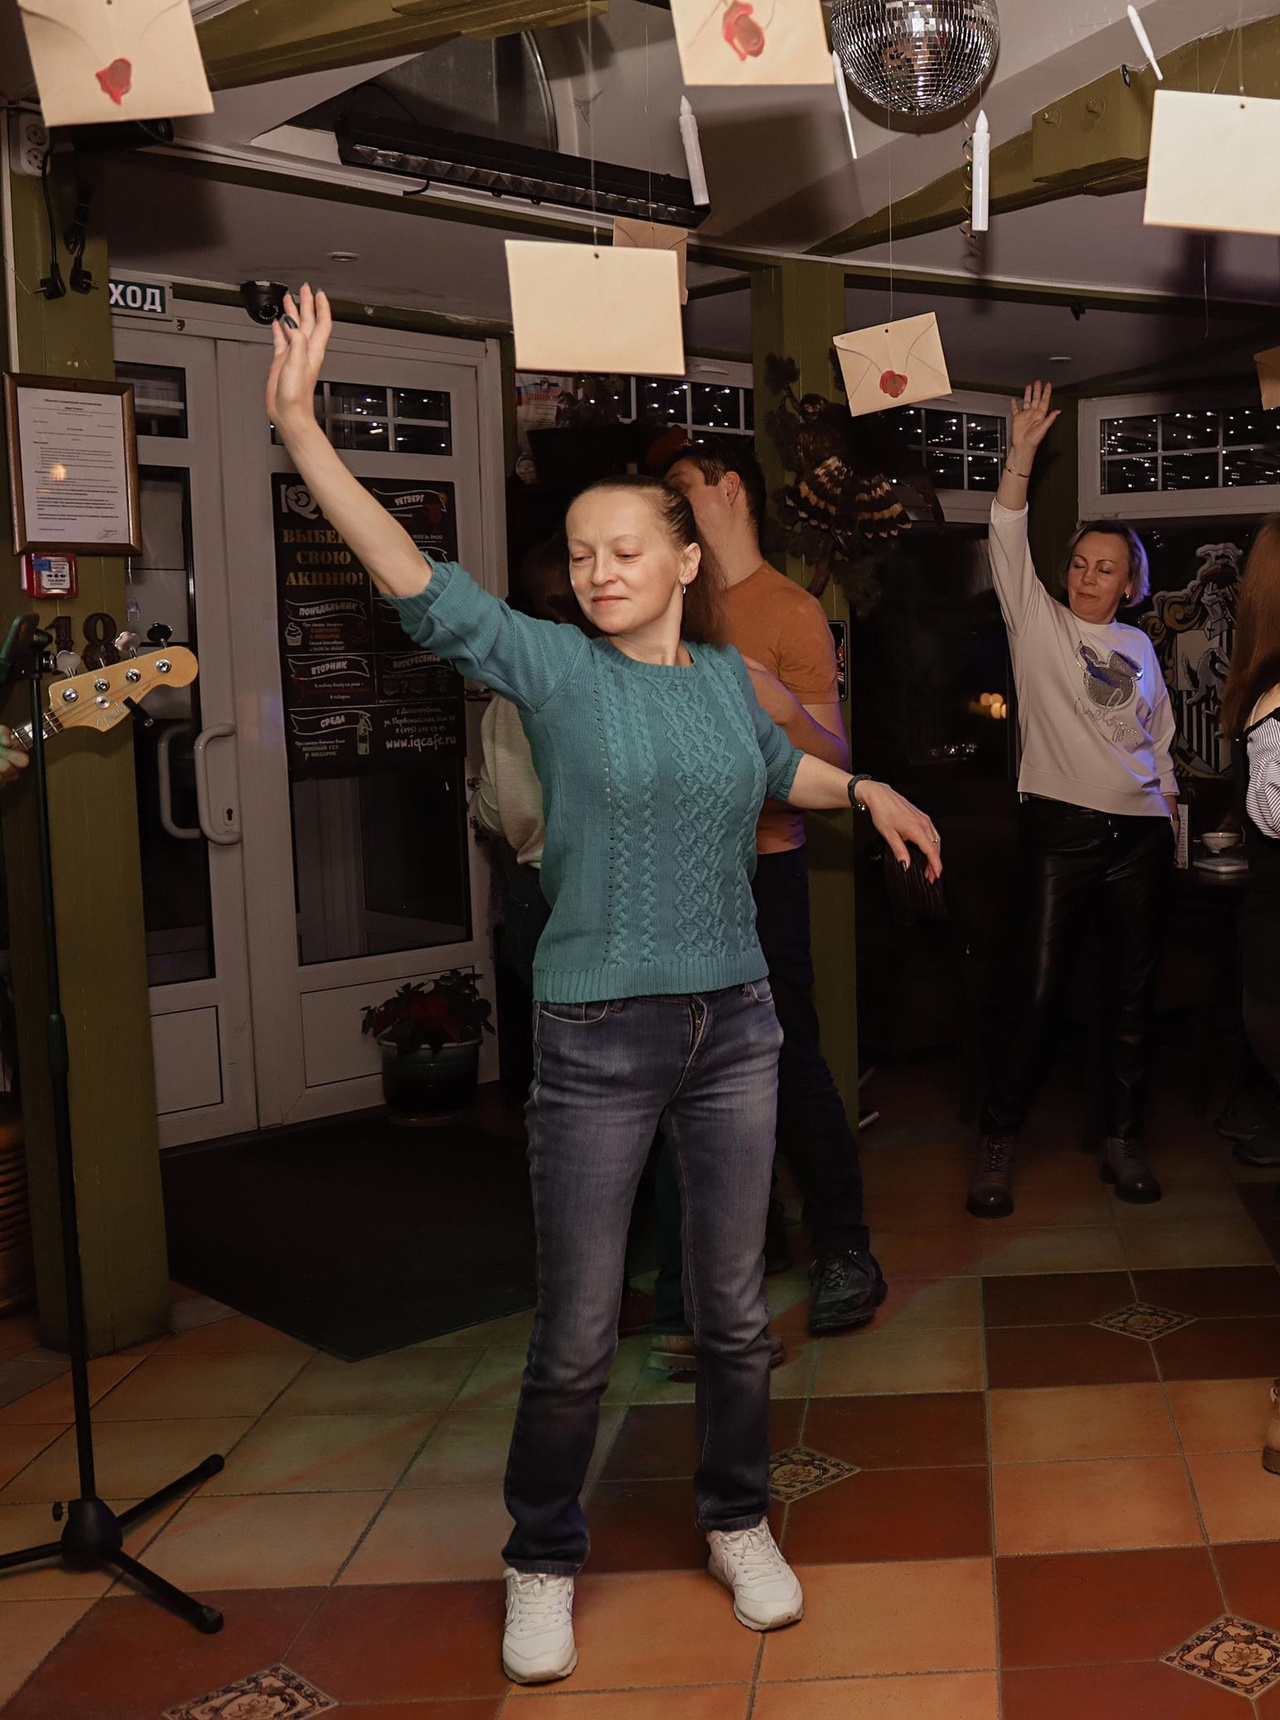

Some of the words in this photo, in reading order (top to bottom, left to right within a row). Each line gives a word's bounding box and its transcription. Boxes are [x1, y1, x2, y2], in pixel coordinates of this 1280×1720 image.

[296, 550, 352, 565] СВОЮ
[285, 571, 364, 586] АКЦИЮ!
[299, 602, 358, 616] ПОНЕДЕЛЬНИК
[310, 660, 348, 675] ВТОРНИК
[320, 715, 346, 728] СРЕДА
[385, 733, 457, 753] www.iqcafe.ru
